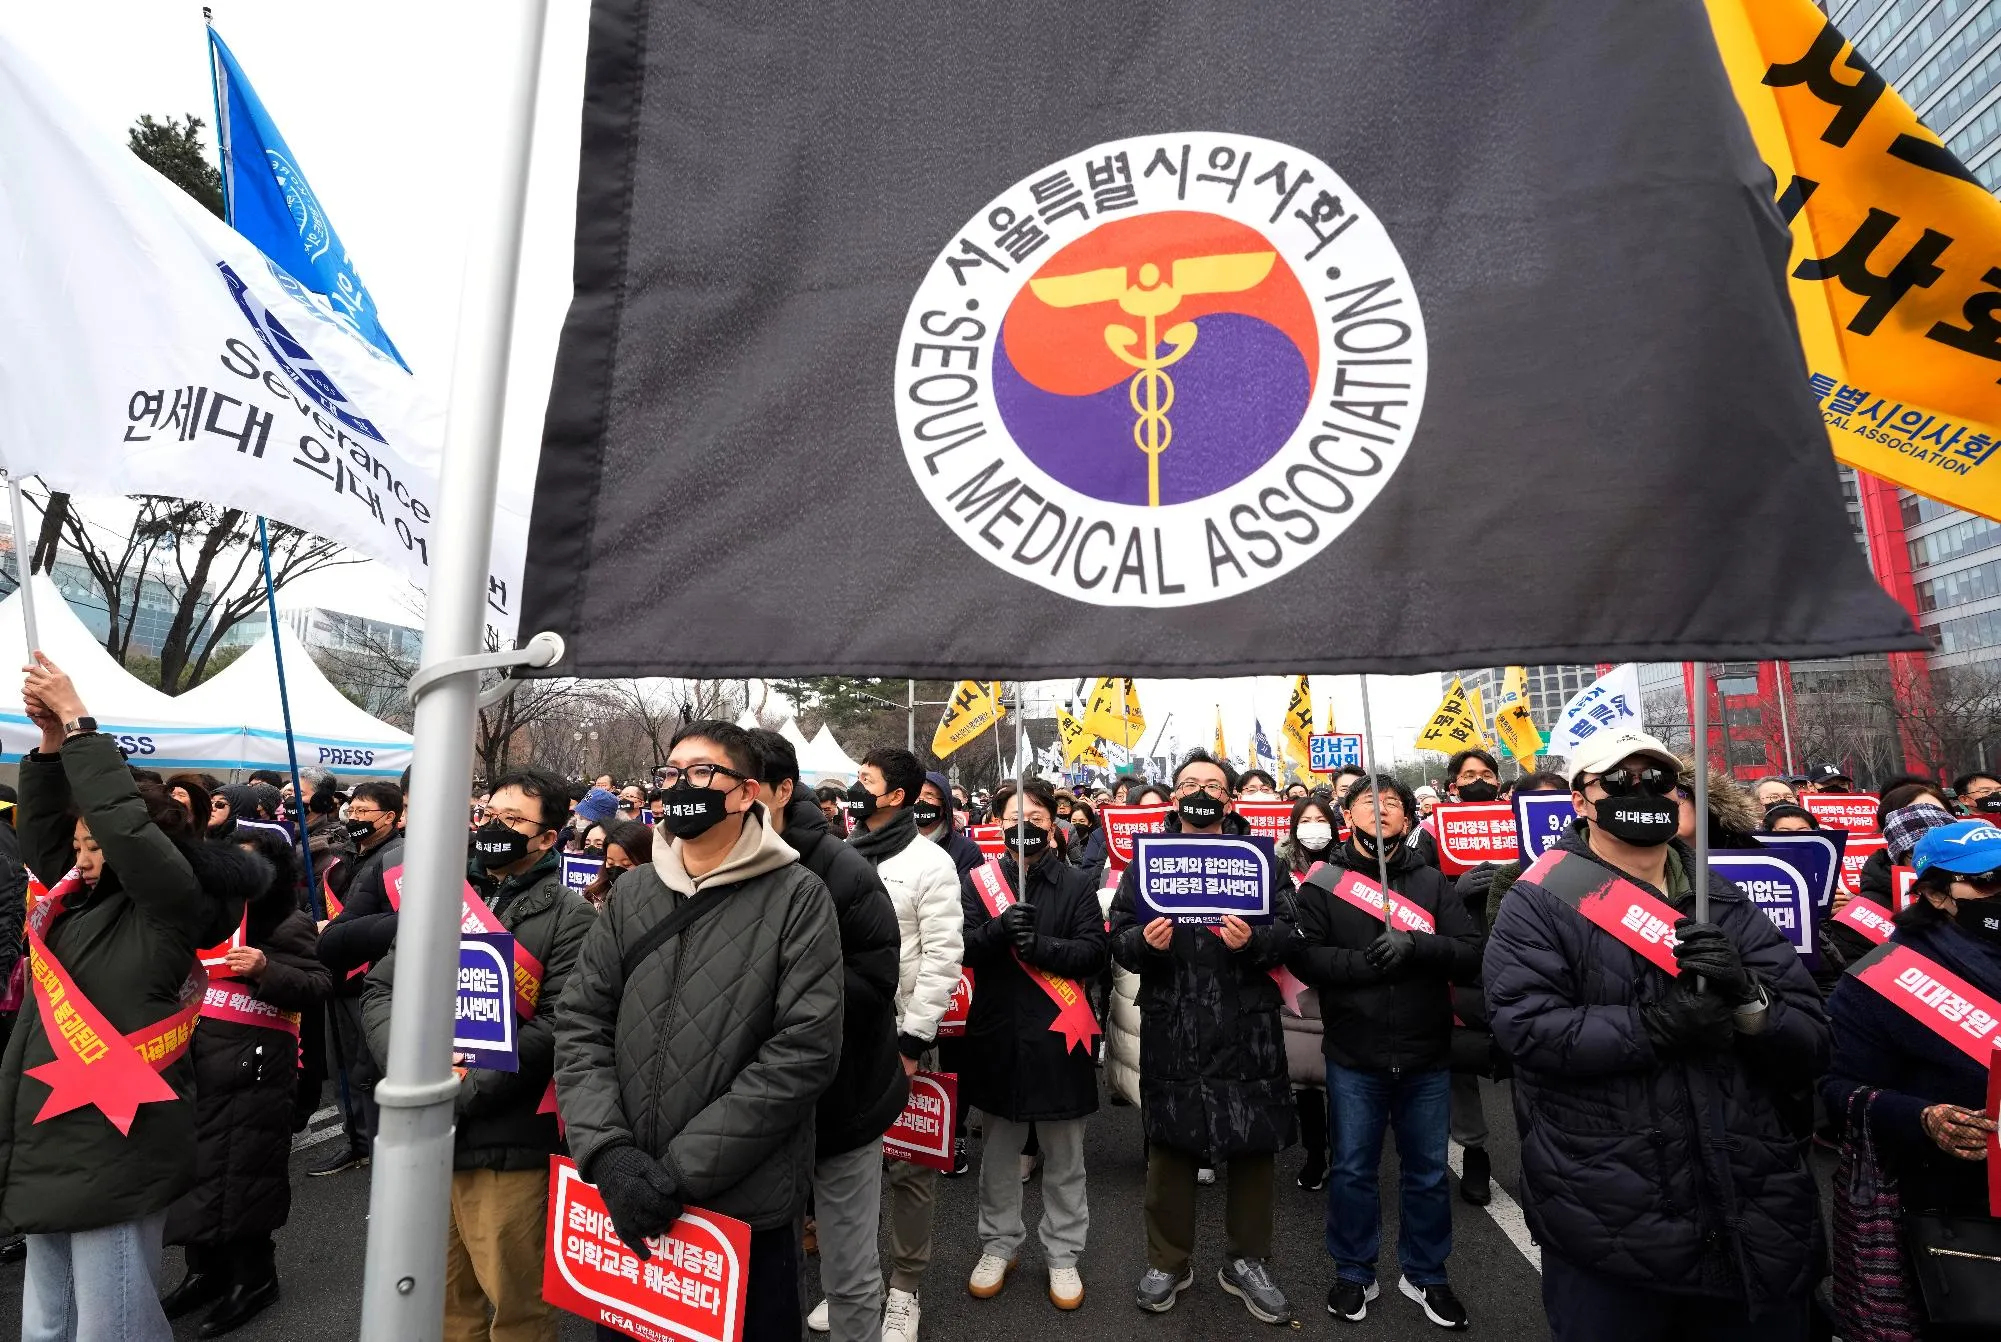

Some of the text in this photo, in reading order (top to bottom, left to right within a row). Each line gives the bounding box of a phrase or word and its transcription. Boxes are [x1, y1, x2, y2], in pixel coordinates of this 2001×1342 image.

[946, 145, 1359, 287] 서울특별시의사회
[220, 337, 431, 524] Severance
[908, 276, 1413, 595] SEOUL MEDICAL ASSOCIATION
[124, 386, 274, 460] 연세대
[292, 435, 386, 526] 의대
[1853, 424, 1973, 476] ASSOCIATION
[1310, 737, 1359, 753] 강남구
[319, 747, 374, 767] PRESS
[1312, 754, 1358, 770] 의사회
[672, 803, 708, 817] 재검토
[1446, 820, 1488, 835] 의대정원
[483, 842, 512, 852] 재검토
[1449, 836, 1490, 850] 의료체계
[1149, 857, 1258, 877] 의료계와 합의없는
[1150, 877, 1259, 898] 의대증원 결사반대
[1178, 916, 1203, 924] KMA
[1893, 967, 2000, 1039] 의대정원
[53, 1000, 110, 1066] 붕괴된다
[566, 1235, 721, 1316] 의학교육 훼손된다
[600, 1308, 635, 1333] KMA
